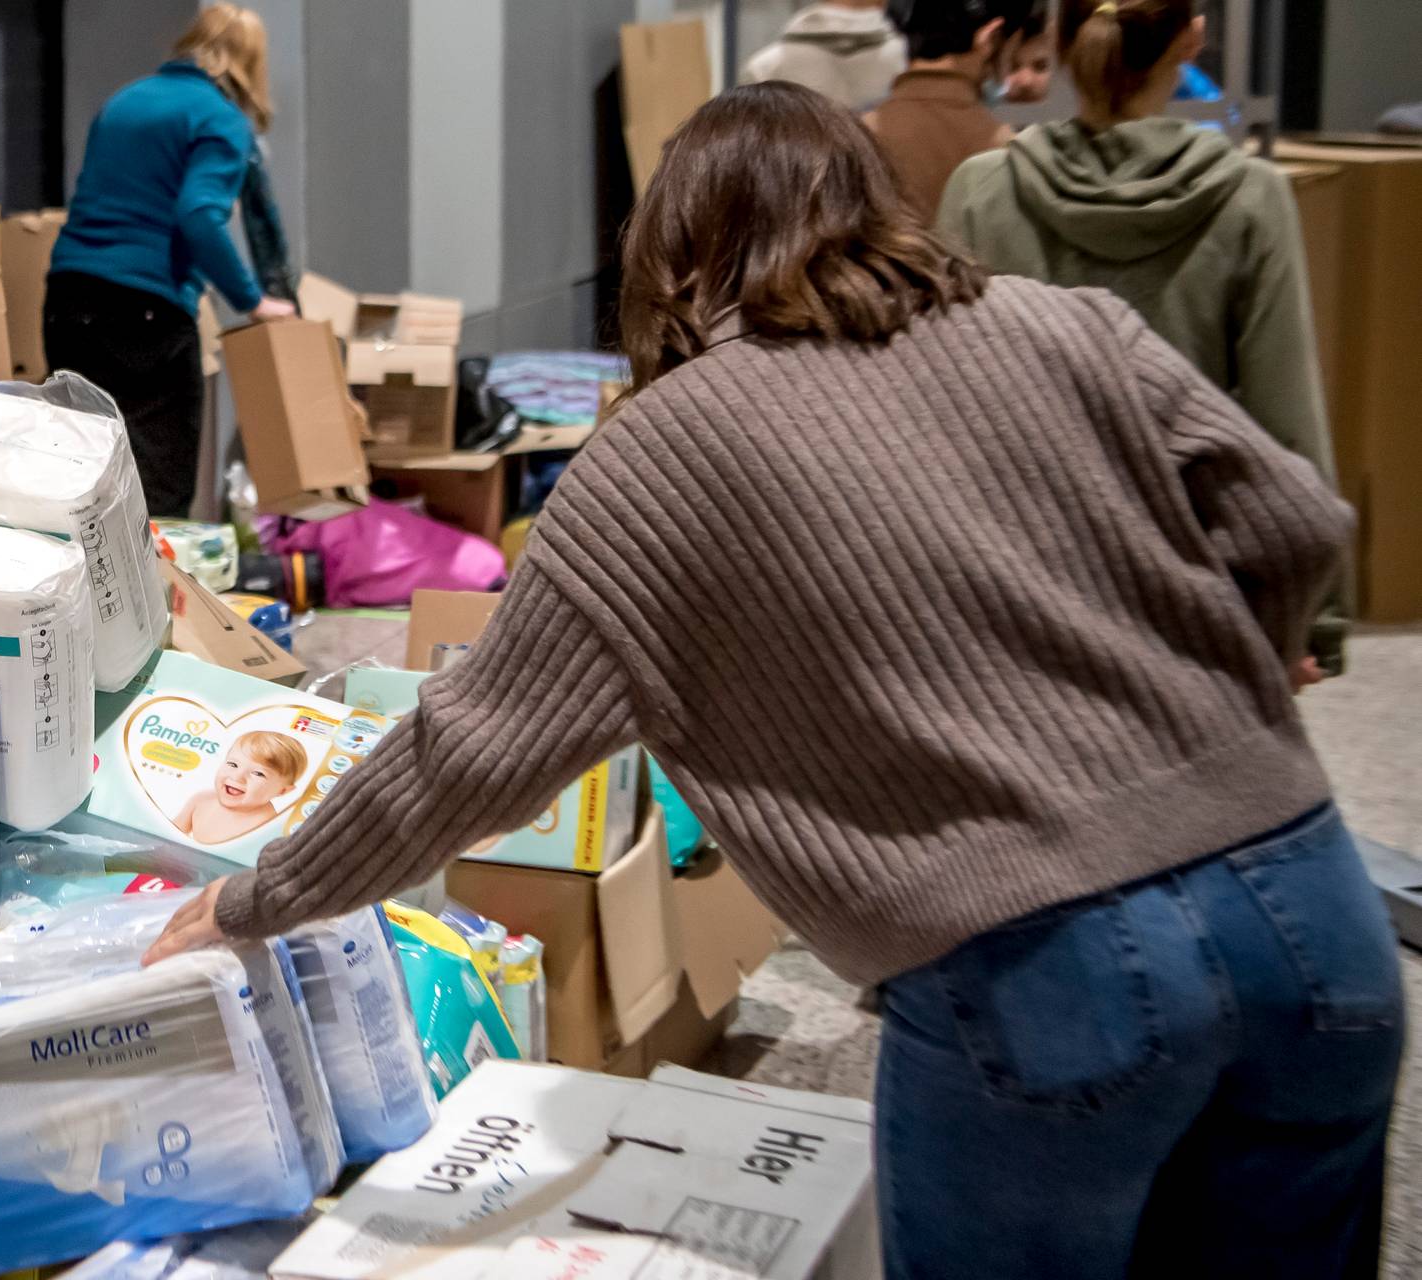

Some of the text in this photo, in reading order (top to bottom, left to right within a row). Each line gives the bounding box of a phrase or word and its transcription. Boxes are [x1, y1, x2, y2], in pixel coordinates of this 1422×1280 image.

[139, 714, 220, 755] Pampers
[29, 1018, 152, 1063] MoliCare
[86, 1045, 158, 1069] Premium
[414, 1113, 535, 1196] öffnen
[737, 1126, 827, 1186] Hier
